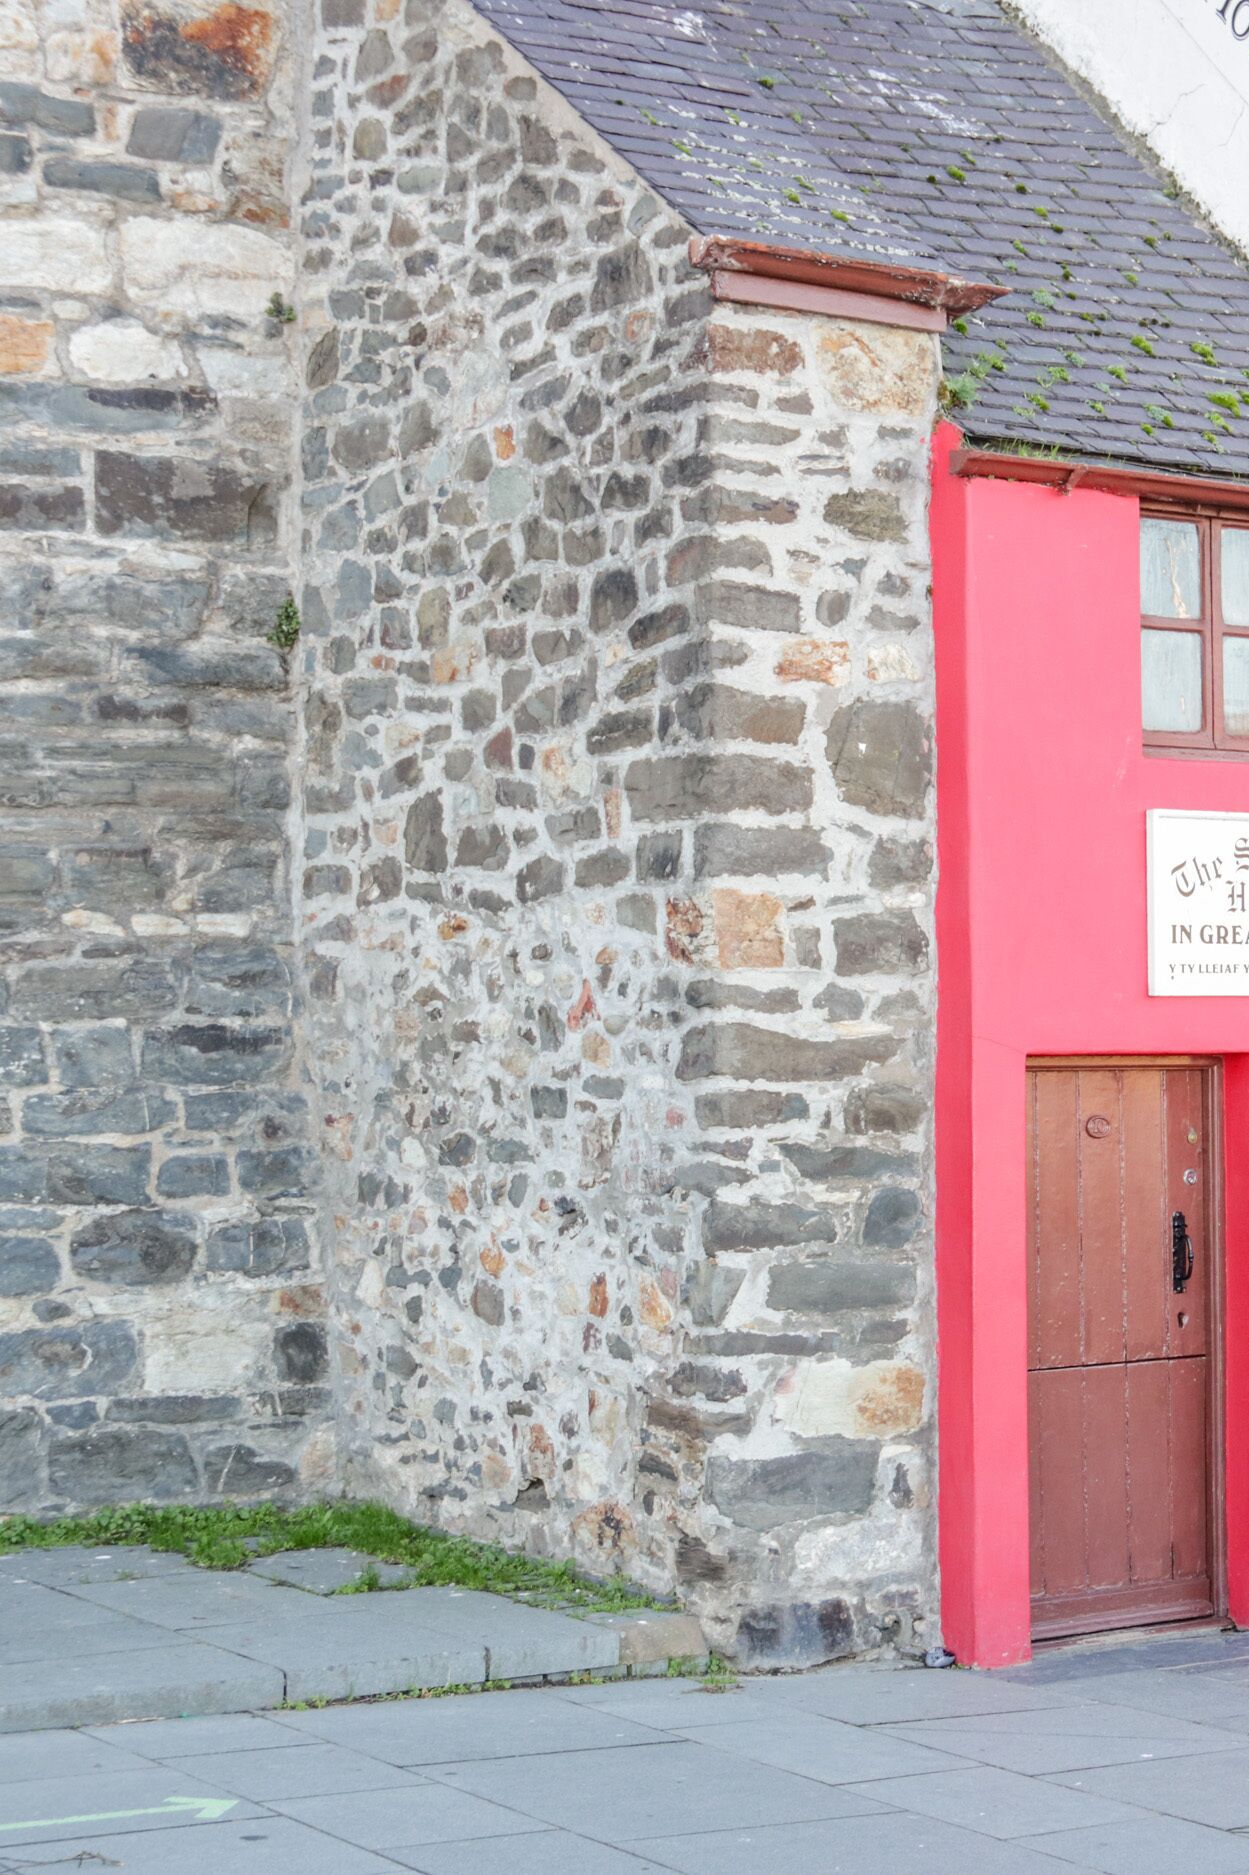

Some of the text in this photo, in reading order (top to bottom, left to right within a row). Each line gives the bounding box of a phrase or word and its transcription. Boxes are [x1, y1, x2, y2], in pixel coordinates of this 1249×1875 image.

[1171, 856, 1223, 898] The
[1171, 924, 1193, 944] IN
[1169, 963, 1177, 974] Y
[1180, 963, 1195, 974] TY
[1199, 963, 1240, 974] LLEIAF
